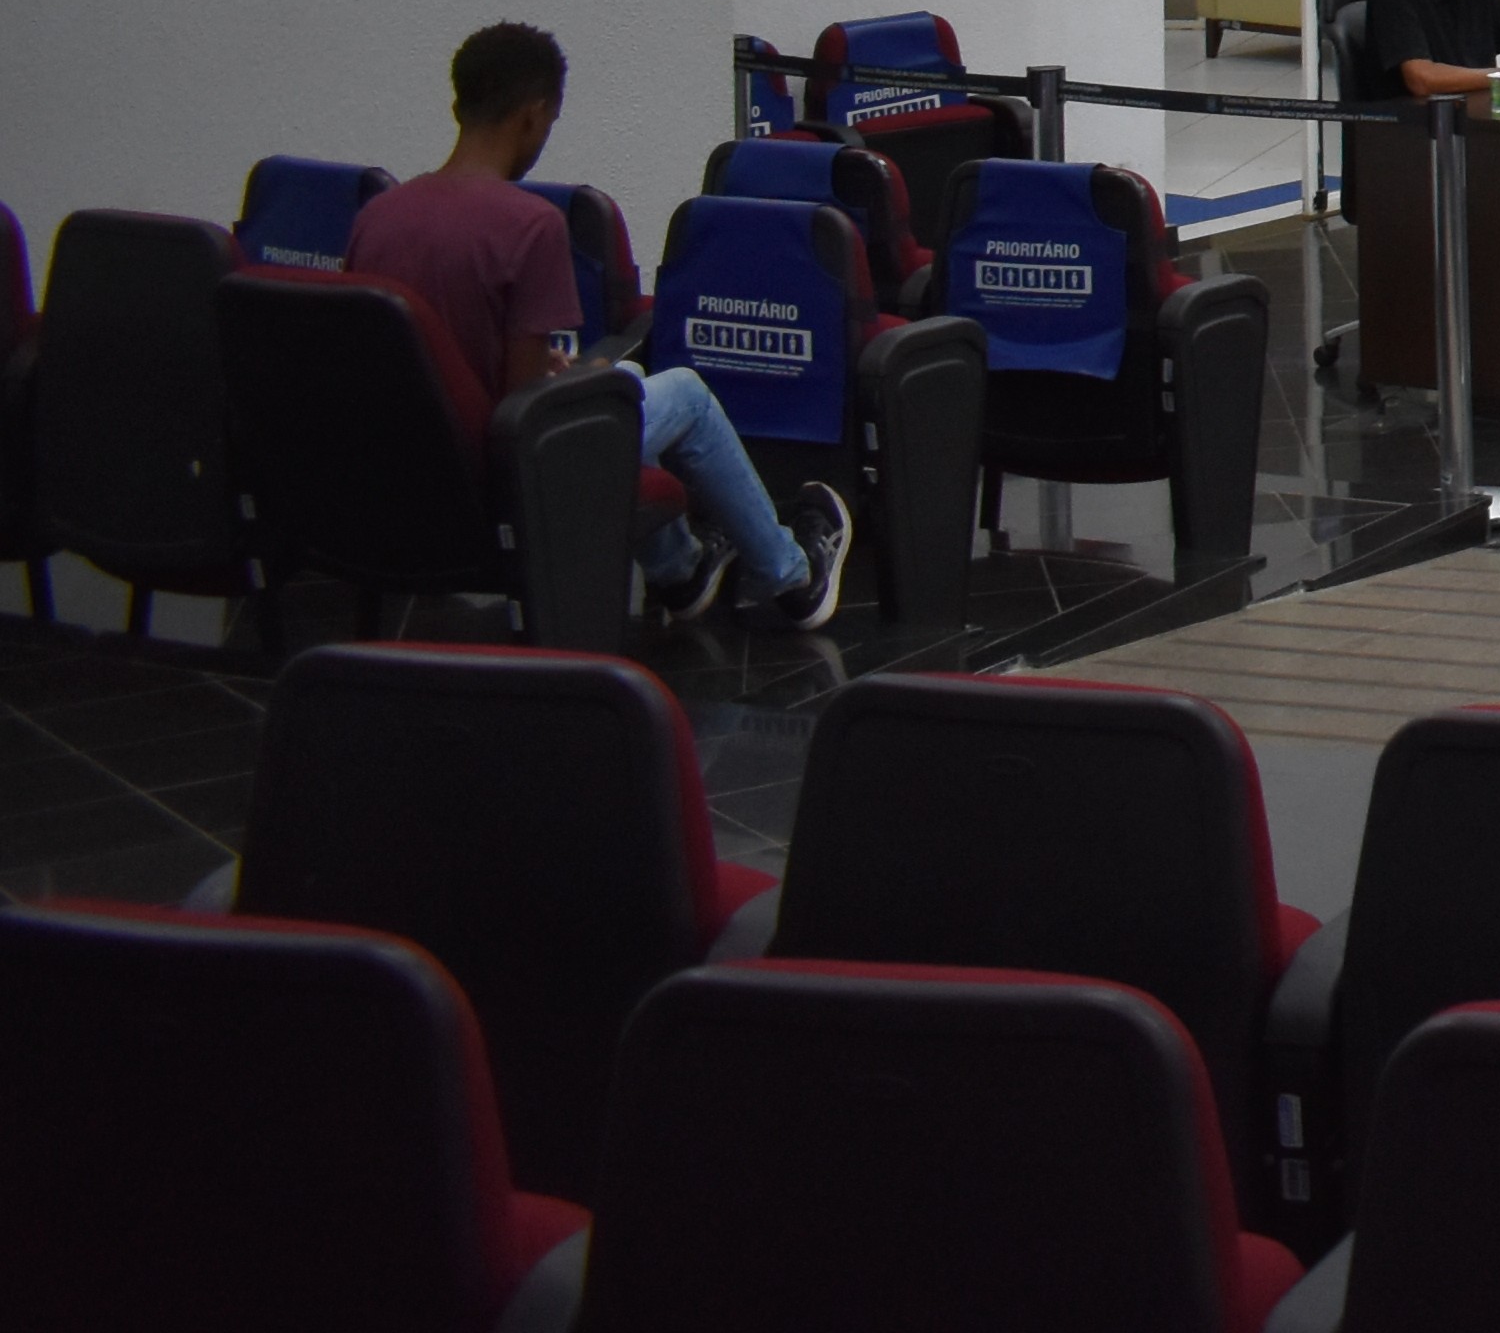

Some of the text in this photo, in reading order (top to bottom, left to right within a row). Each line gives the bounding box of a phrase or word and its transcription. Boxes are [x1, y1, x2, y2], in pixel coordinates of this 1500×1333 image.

[263, 245, 345, 274] PRIORITÁRIO
[986, 239, 1080, 259] PRIORITÁRIO
[698, 295, 799, 322] PRIORITÁRIO
